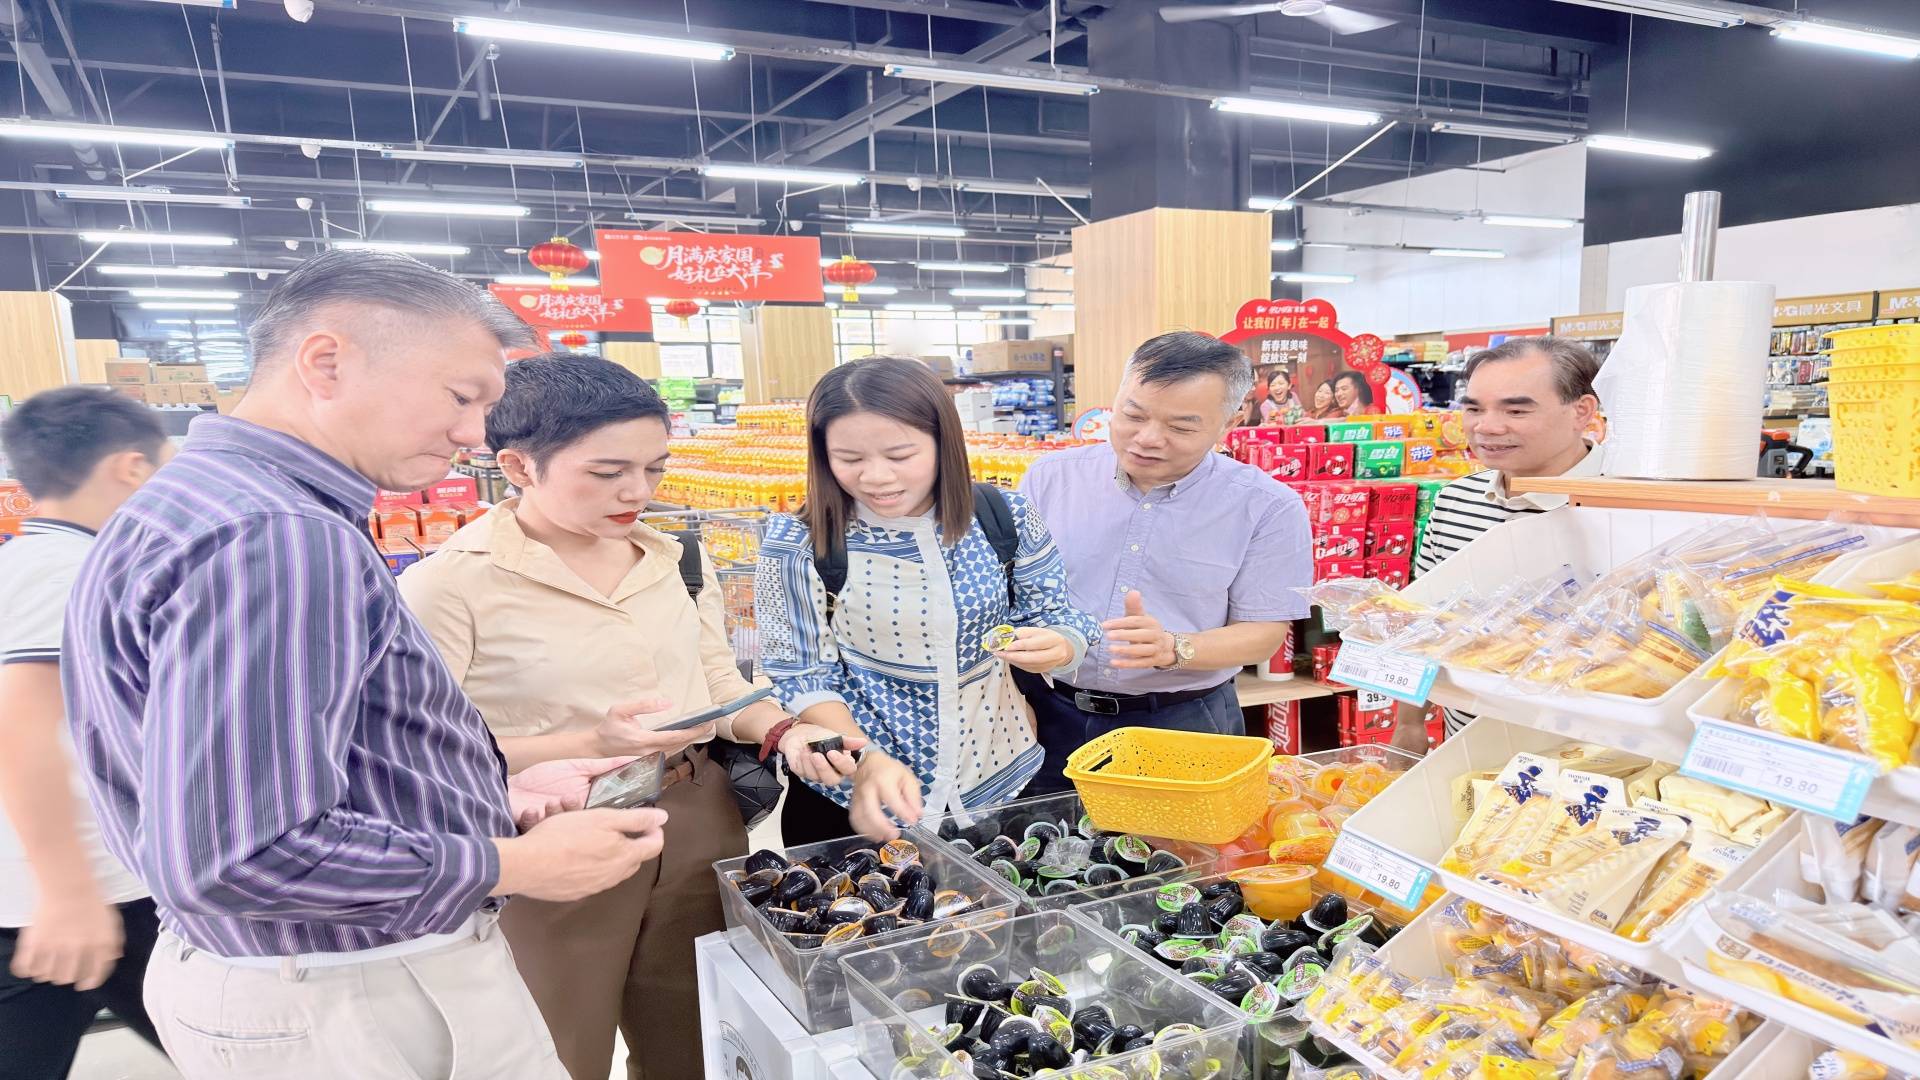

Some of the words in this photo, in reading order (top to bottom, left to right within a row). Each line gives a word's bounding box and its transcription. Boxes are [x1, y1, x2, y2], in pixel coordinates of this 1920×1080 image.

[659, 244, 753, 268] 月满庆家国
[668, 261, 773, 290] 好礼在大洋
[1368, 445, 1400, 460] 雪碧
[1409, 445, 1435, 462] 芬达
[1384, 673, 1409, 686] 19.80
[1774, 774, 1819, 794] 19.80
[1376, 873, 1400, 890] 19.80
